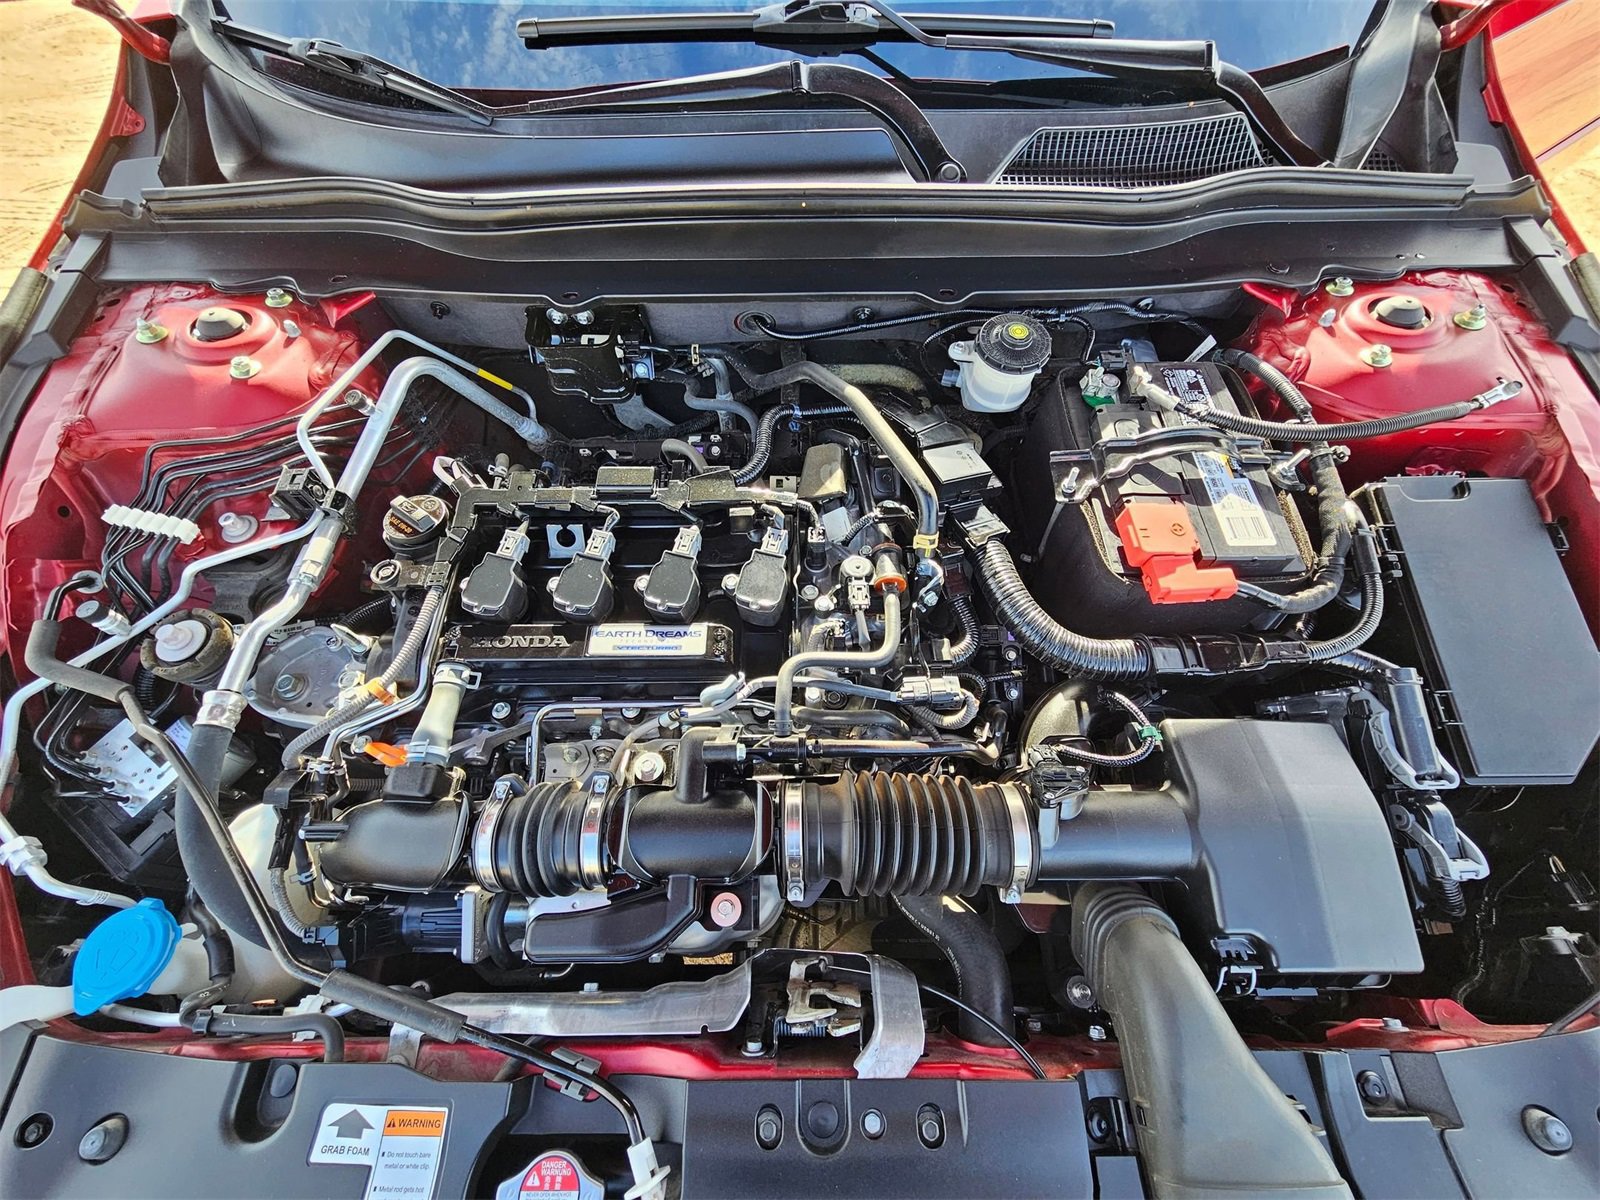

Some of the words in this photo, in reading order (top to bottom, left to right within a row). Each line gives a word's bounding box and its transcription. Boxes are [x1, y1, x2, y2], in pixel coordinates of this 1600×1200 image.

[595, 630, 641, 638] EARTH
[645, 629, 702, 638] DREAMS
[470, 635, 571, 648] HONDA
[398, 1119, 441, 1129] WARNING
[320, 1145, 345, 1155] GRAB
[346, 1146, 370, 1156] FOAM
[541, 1160, 567, 1168] DANGER
[541, 1168, 572, 1176] WARNUNG
